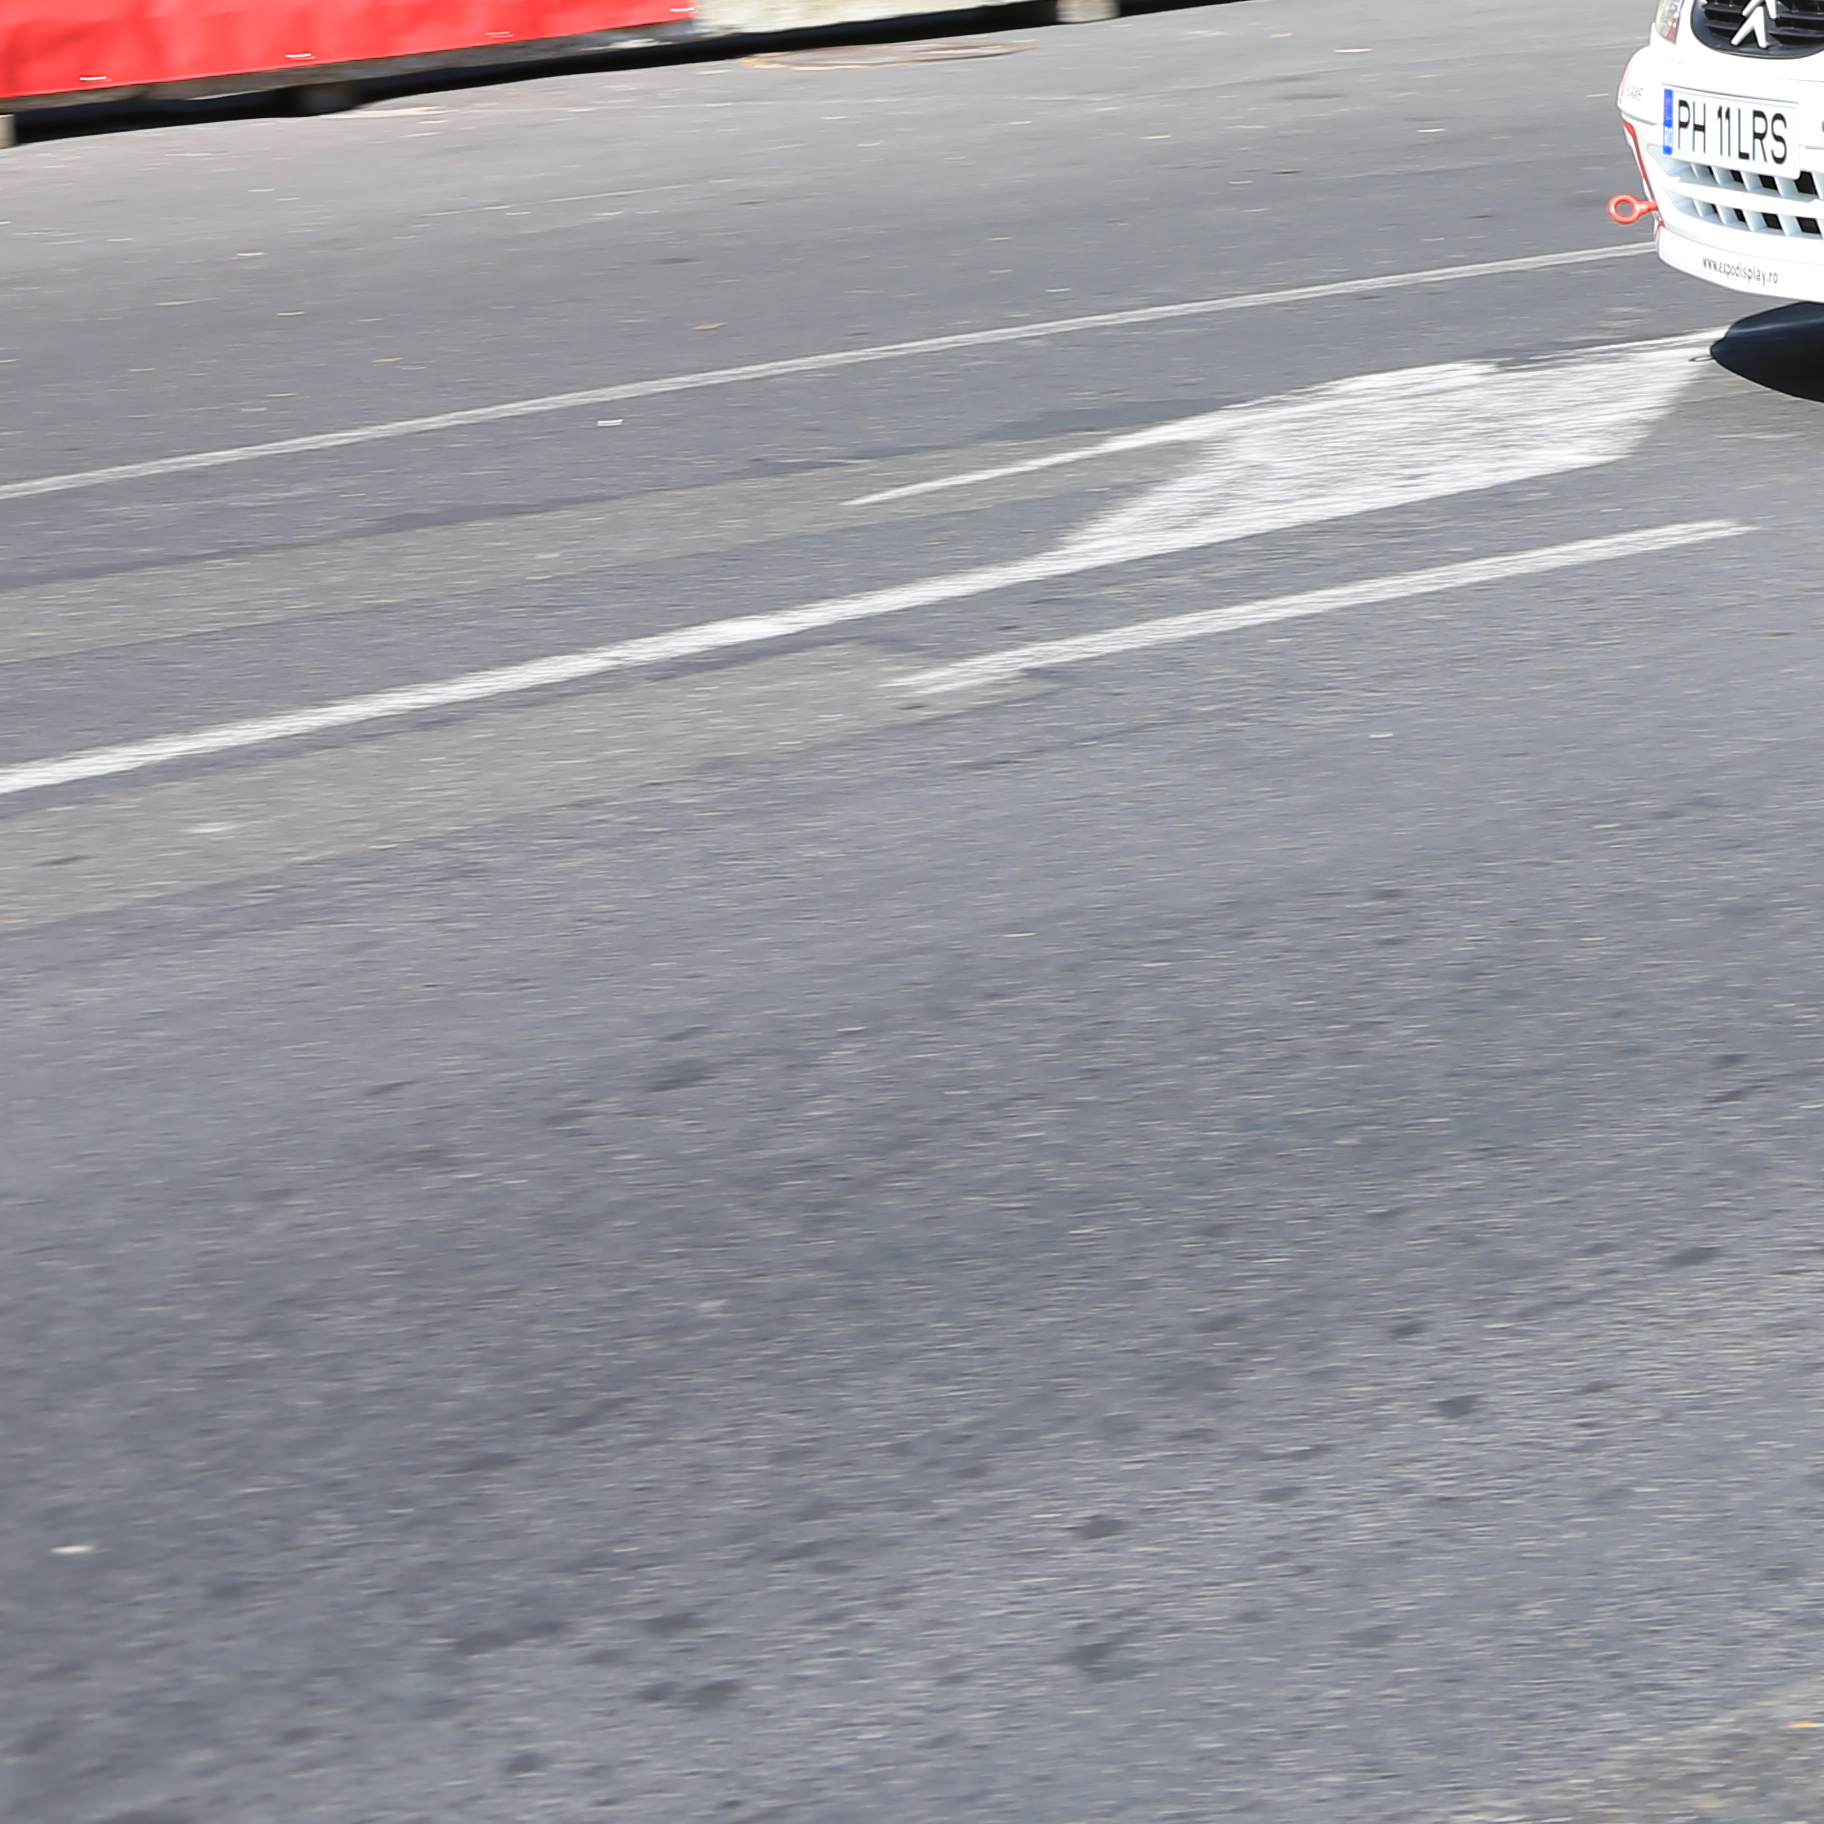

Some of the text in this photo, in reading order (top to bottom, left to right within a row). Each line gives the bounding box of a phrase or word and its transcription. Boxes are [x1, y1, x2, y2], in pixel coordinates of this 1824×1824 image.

[1677, 98, 1788, 165] PH 11 LRS
